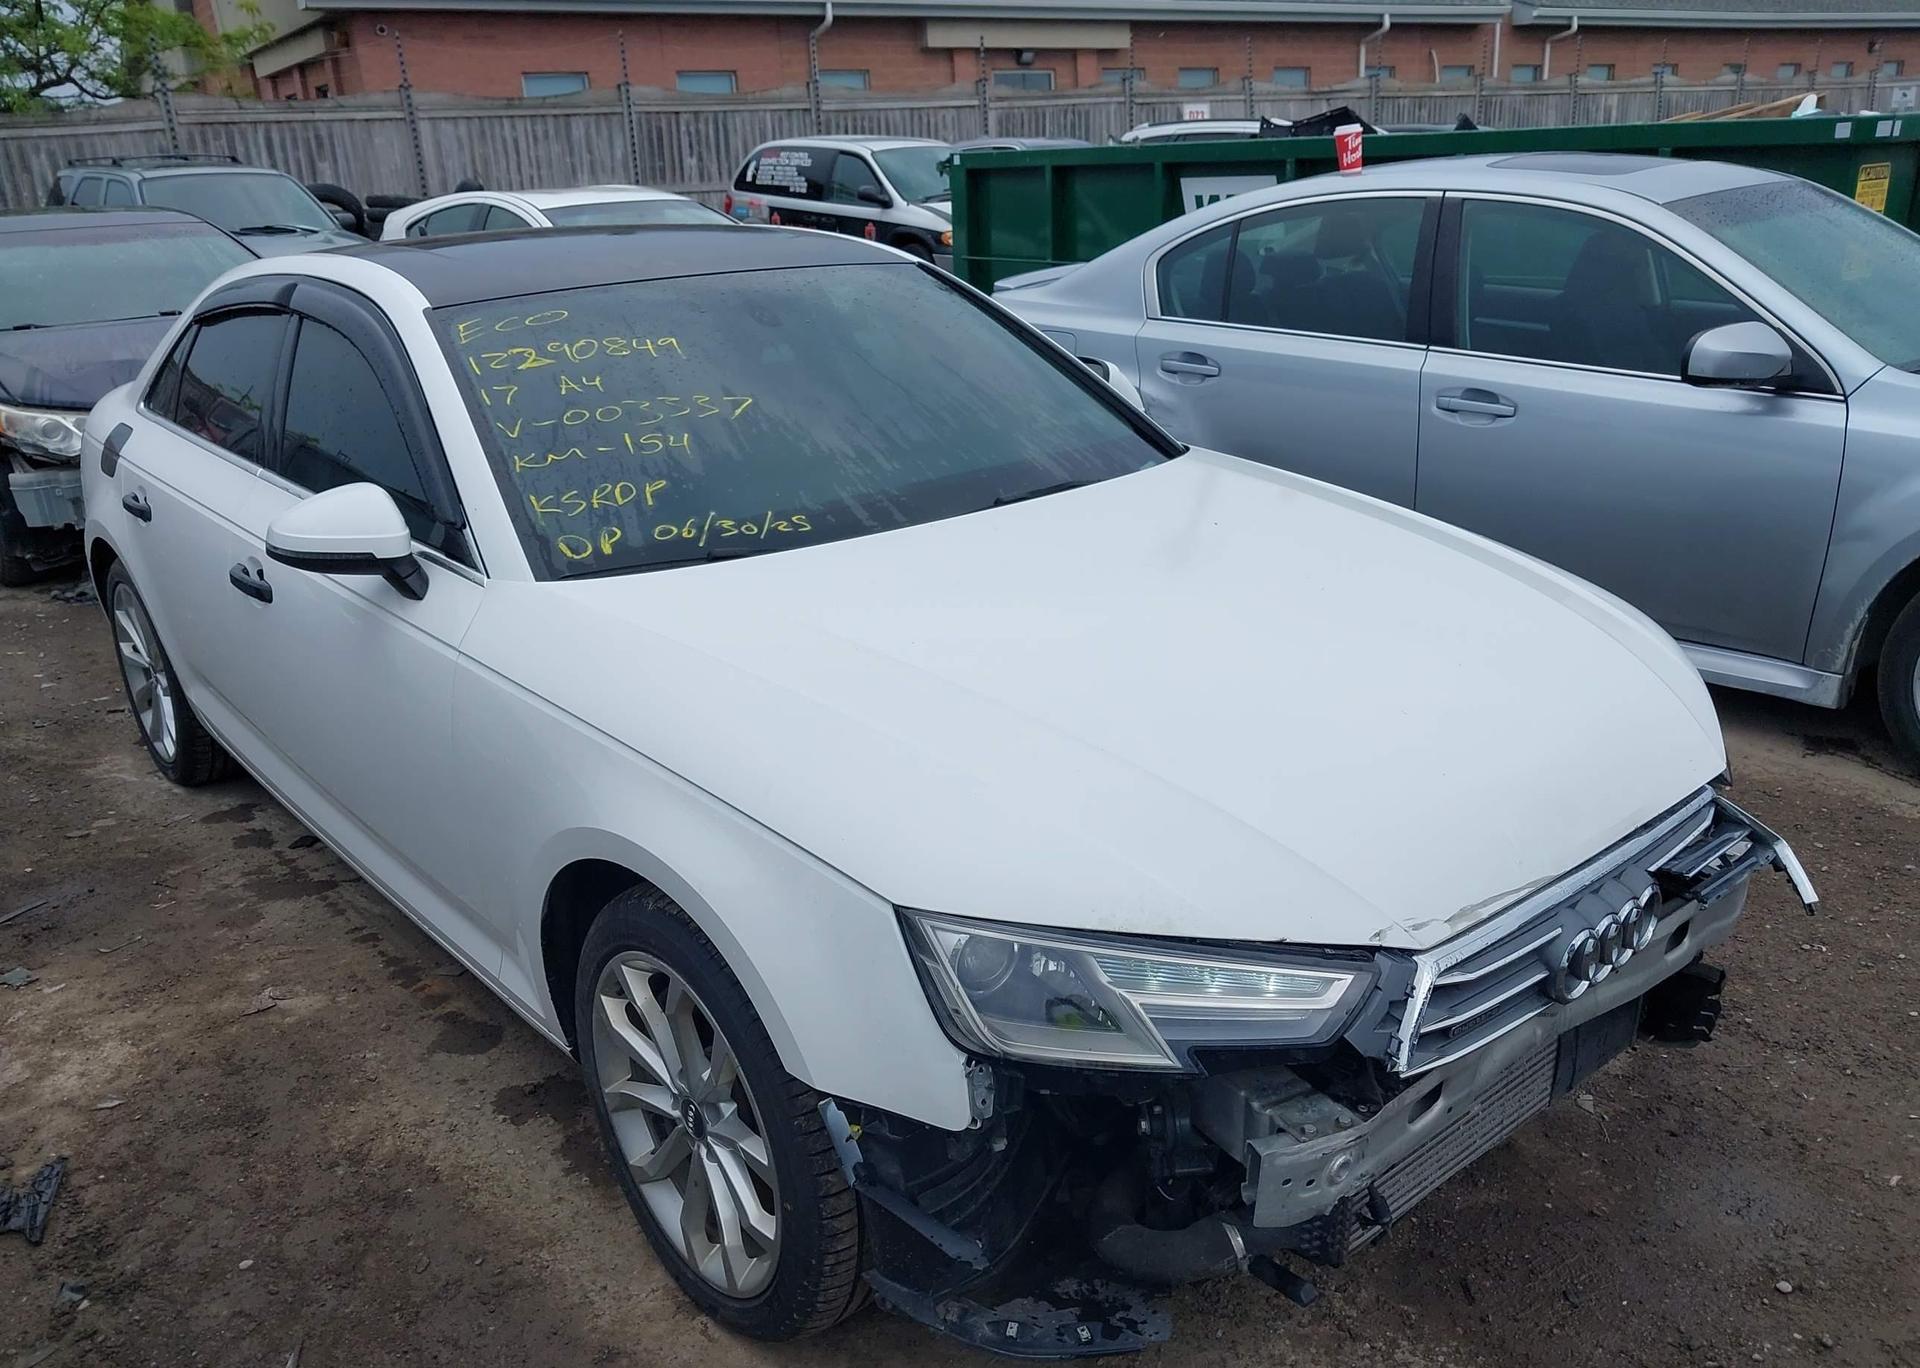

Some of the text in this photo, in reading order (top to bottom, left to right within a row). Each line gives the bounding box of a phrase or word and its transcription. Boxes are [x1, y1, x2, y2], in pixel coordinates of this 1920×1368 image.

[457, 311, 568, 345] ECO
[480, 374, 605, 405] 17 A4
